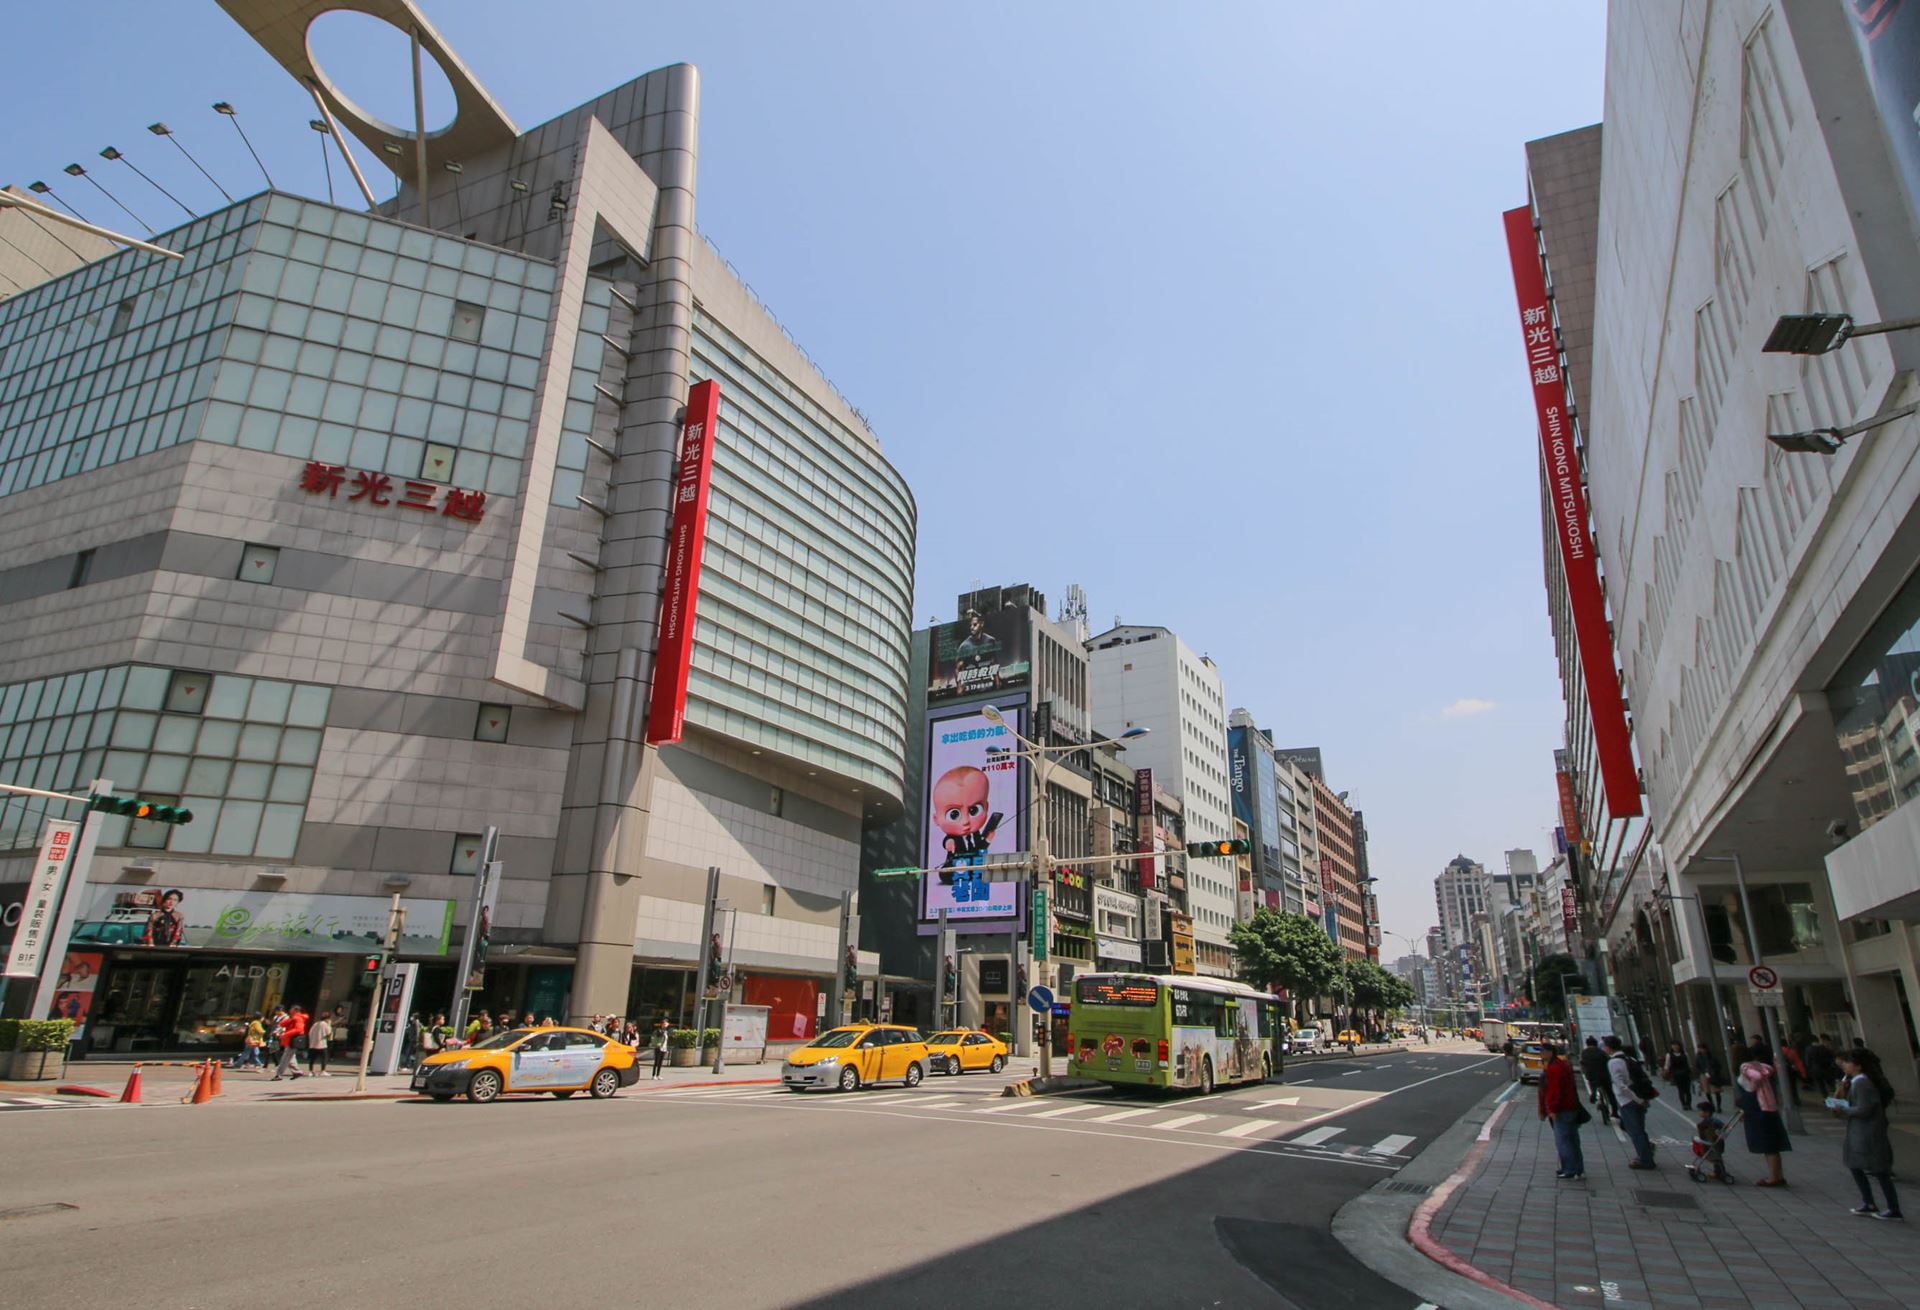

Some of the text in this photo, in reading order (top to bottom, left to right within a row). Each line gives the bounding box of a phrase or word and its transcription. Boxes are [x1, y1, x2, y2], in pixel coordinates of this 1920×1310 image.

[1523, 305, 1558, 385] 新光三越
[299, 461, 487, 524] 新光三越
[679, 422, 703, 503] 新光三越
[1546, 406, 1584, 559] SHIN KONG MITSUKOSHI
[668, 524, 687, 639] SHIN KONG MITSUKOSHI
[1231, 756, 1246, 793] Tango
[216, 964, 284, 979] ALDO
